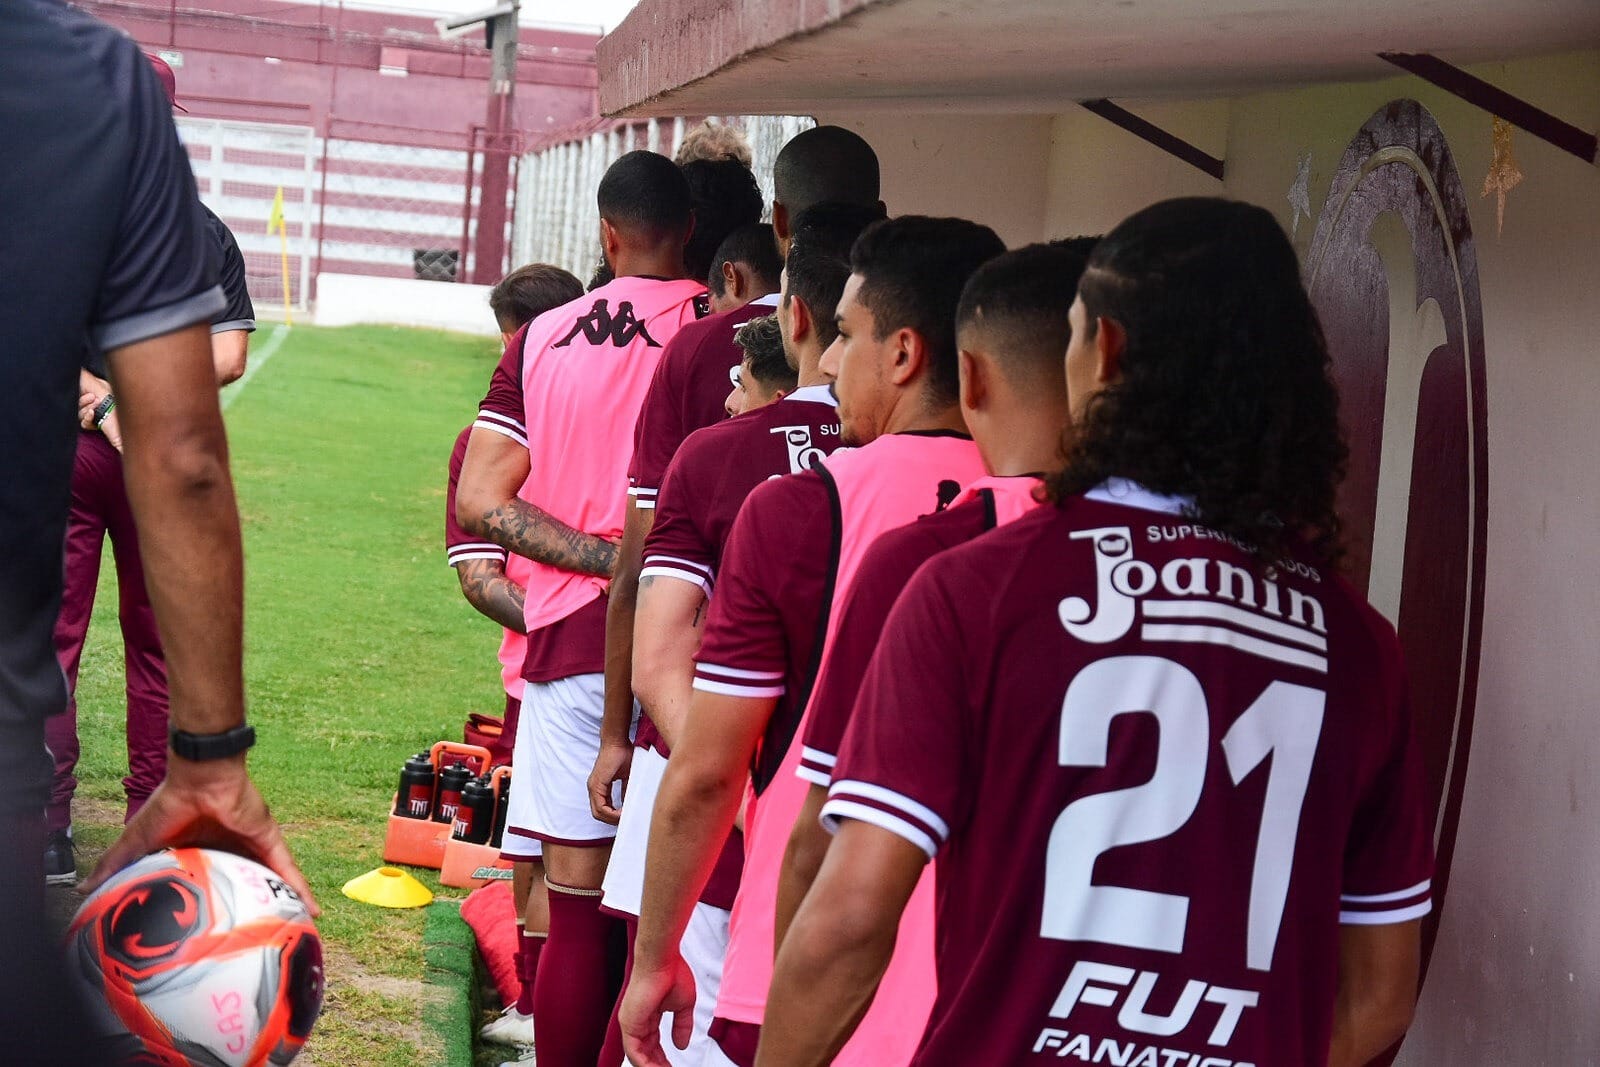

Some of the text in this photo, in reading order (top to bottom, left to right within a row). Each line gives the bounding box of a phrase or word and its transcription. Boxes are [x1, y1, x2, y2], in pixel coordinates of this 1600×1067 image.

[1058, 526, 1328, 643] Joanin
[1040, 655, 1326, 972] 21
[1048, 960, 1260, 1047] FUT
